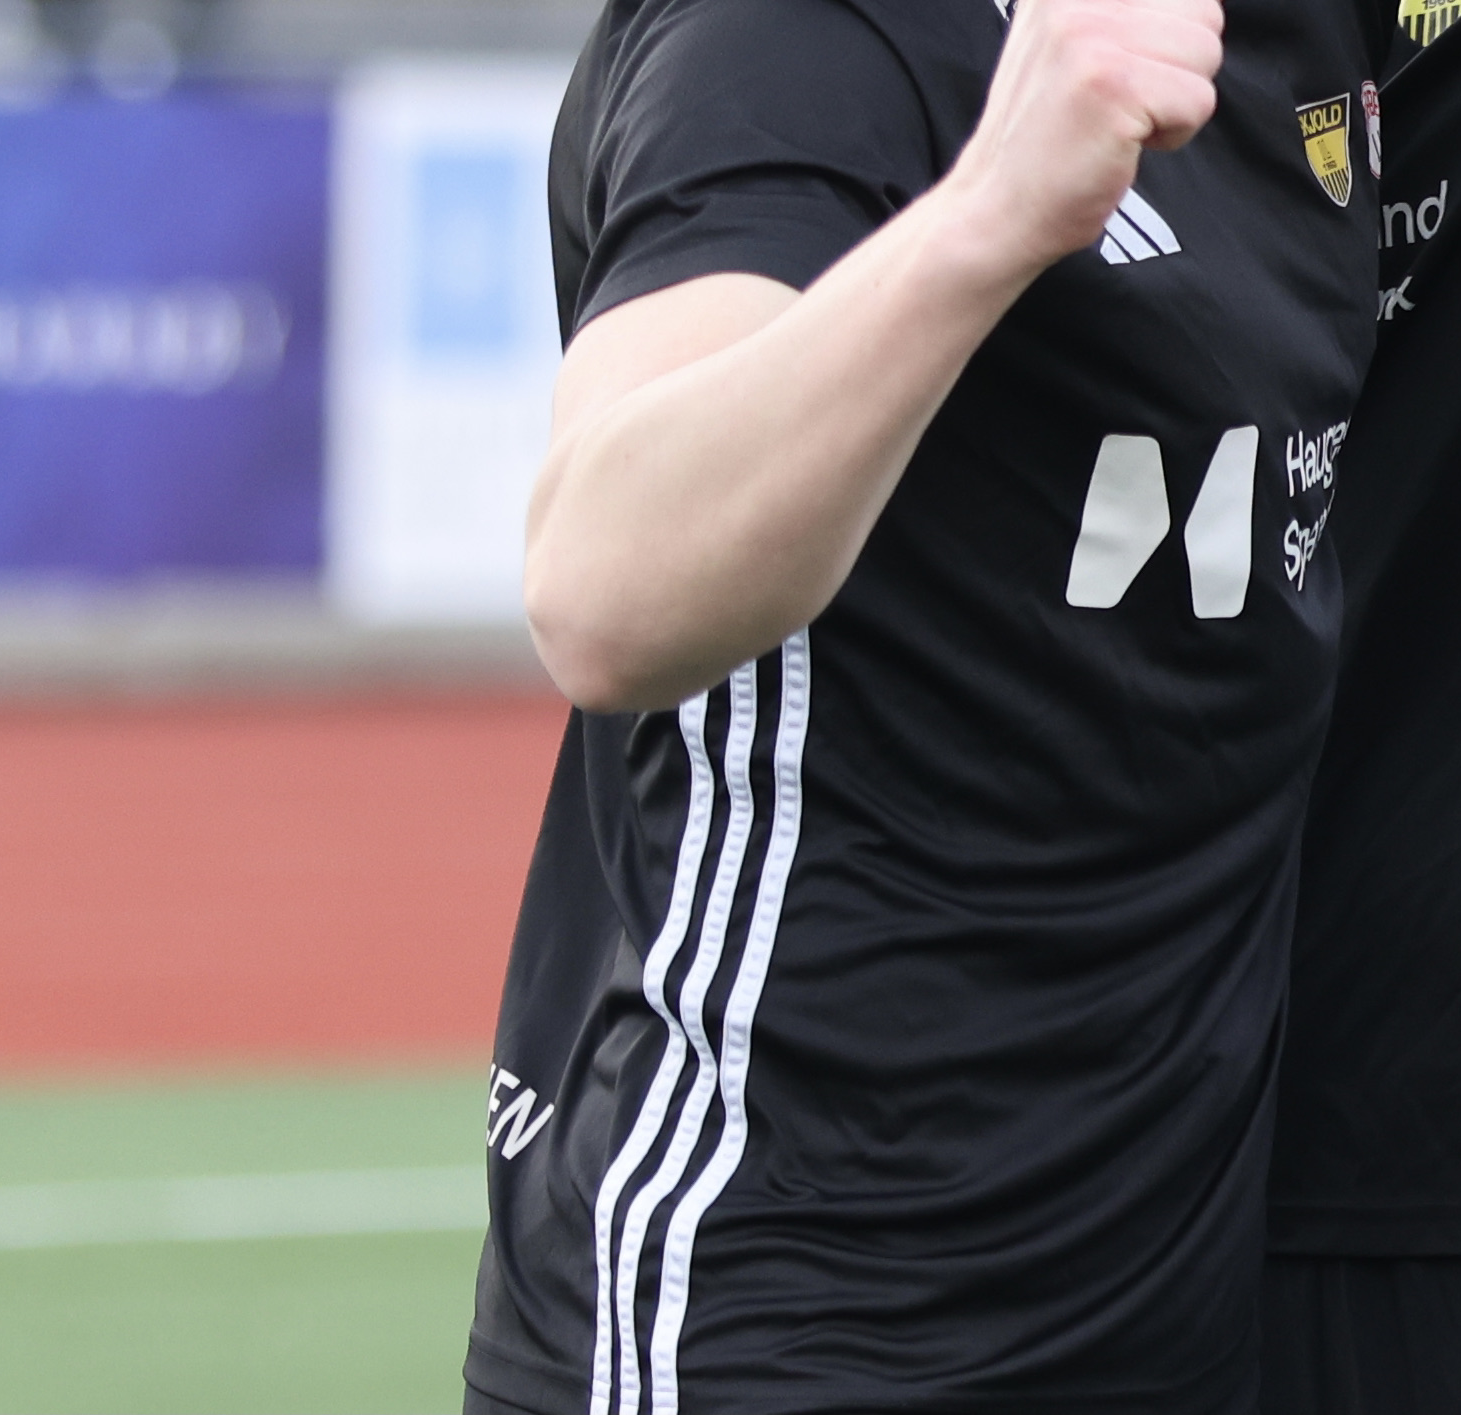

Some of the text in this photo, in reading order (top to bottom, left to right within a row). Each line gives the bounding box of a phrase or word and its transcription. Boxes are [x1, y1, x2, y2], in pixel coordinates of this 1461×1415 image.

[1378, 180, 1448, 249] nd
[1286, 416, 1351, 498] Hauge
[487, 1063, 555, 1161] EN
